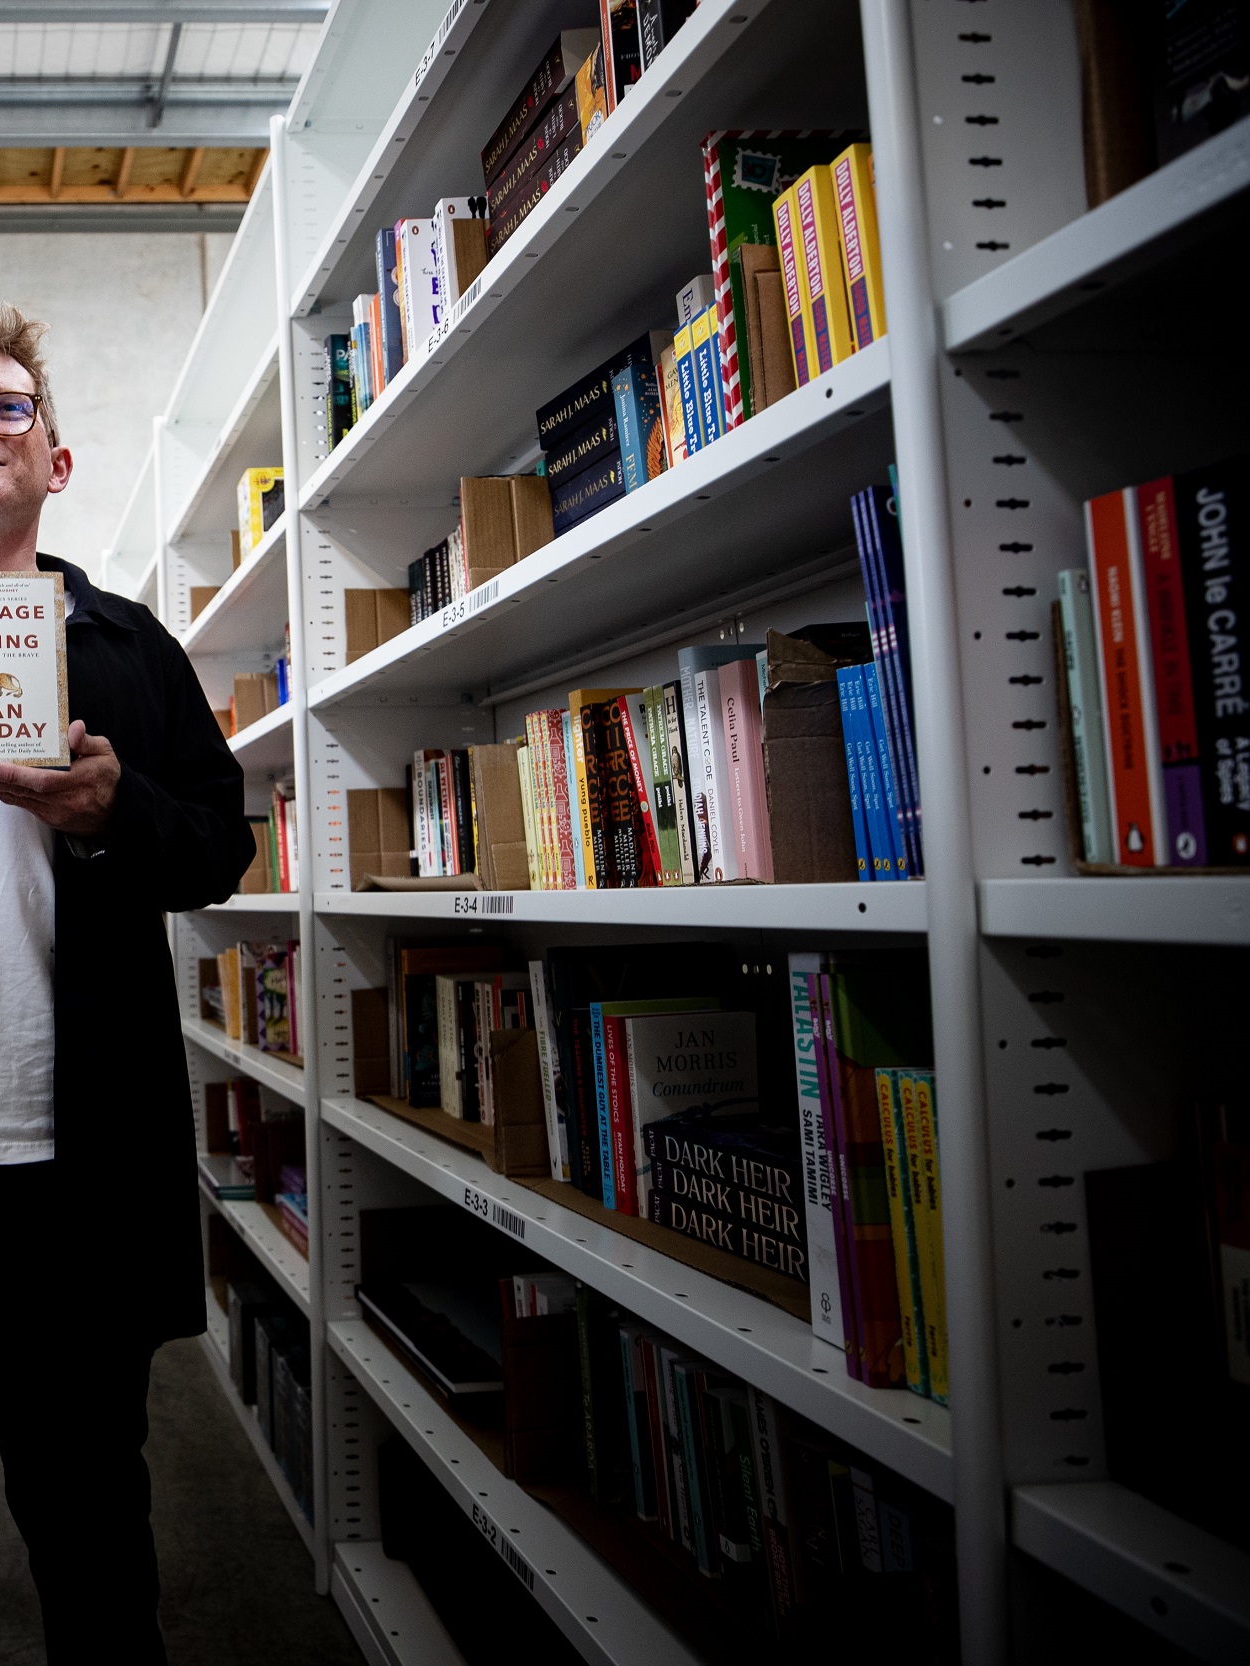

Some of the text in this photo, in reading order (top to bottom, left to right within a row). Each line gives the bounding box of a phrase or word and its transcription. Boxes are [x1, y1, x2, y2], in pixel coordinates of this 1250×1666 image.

[416, 40, 435, 86] E-3-7
[486, 105, 528, 174] SARAH MAAS
[491, 145, 538, 214] SARAH MAAS
[491, 188, 542, 252] SARAH MAAS
[798, 182, 822, 297] DOLLY ALDERTON
[836, 162, 862, 279] DOLLY ALDERTON
[778, 203, 800, 315] DOLLY ALDERTON
[428, 318, 450, 354] E-3-6
[540, 385, 601, 435] SARAH MAAS
[620, 394, 628, 420] Janina
[681, 361, 694, 436] Little Blue
[698, 349, 712, 424] Little Blue
[548, 431, 601, 478] SARAH MAAS
[554, 474, 609, 517] SARAH MAAS
[442, 602, 464, 628] E-3-5
[1196, 486, 1246, 720] JOHN le CARRÉ
[666, 696, 676, 716] H
[700, 706, 710, 750] TALENT
[727, 697, 740, 764] Celia Paul
[620, 710, 643, 794] THE PRICE MONEY
[648, 706, 660, 778] PATRICIA GRACE
[657, 704, 668, 776] PATRICIA GRACE
[704, 752, 712, 780] CODE
[574, 714, 584, 762] lighter
[582, 807, 590, 848] pueblo
[417, 772, 426, 850] BOUNDARIES
[708, 788, 720, 855] DANIEL COYLE
[597, 830, 606, 876] MADELINE
[628, 827, 637, 877] MADELINE
[454, 897, 478, 914] E-3-4
[539, 1031, 548, 1056] FIBRE
[592, 1017, 600, 1040] THE
[606, 1024, 614, 1050] LIVES
[675, 1030, 715, 1048] JAN
[792, 970, 823, 1101] FALASTIN
[595, 1041, 604, 1090] DUMBEST
[609, 1054, 615, 1064] OF
[656, 1050, 738, 1073] MORRIS
[598, 1092, 606, 1111] GUY
[652, 1079, 745, 1098] Conundrum
[664, 1134, 794, 1204] DARK HEIR
[802, 1108, 818, 1206] SAMI TAMIMI
[880, 1083, 894, 1146] CALCULUS
[888, 1164, 897, 1198] babies
[904, 1087, 922, 1205] CALCULUS for babies
[918, 1091, 932, 1155] CALCULUS
[927, 1174, 936, 1211] babies
[618, 1150, 626, 1194] HOLIDAY
[819, 1152, 833, 1212] WIGLEY
[464, 1188, 488, 1217] E-3-3
[654, 1194, 662, 1224] PACAT
[672, 1168, 802, 1243] DARK HEIR
[670, 1201, 806, 1282] DARK HEIR
[753, 1388, 775, 1497] JAMES O'BRIEN
[472, 1502, 498, 1546] E-3-2
[739, 1453, 763, 1552] Silent Earth
[769, 1528, 779, 1564] BROKE
[888, 1512, 904, 1569] DEEP
